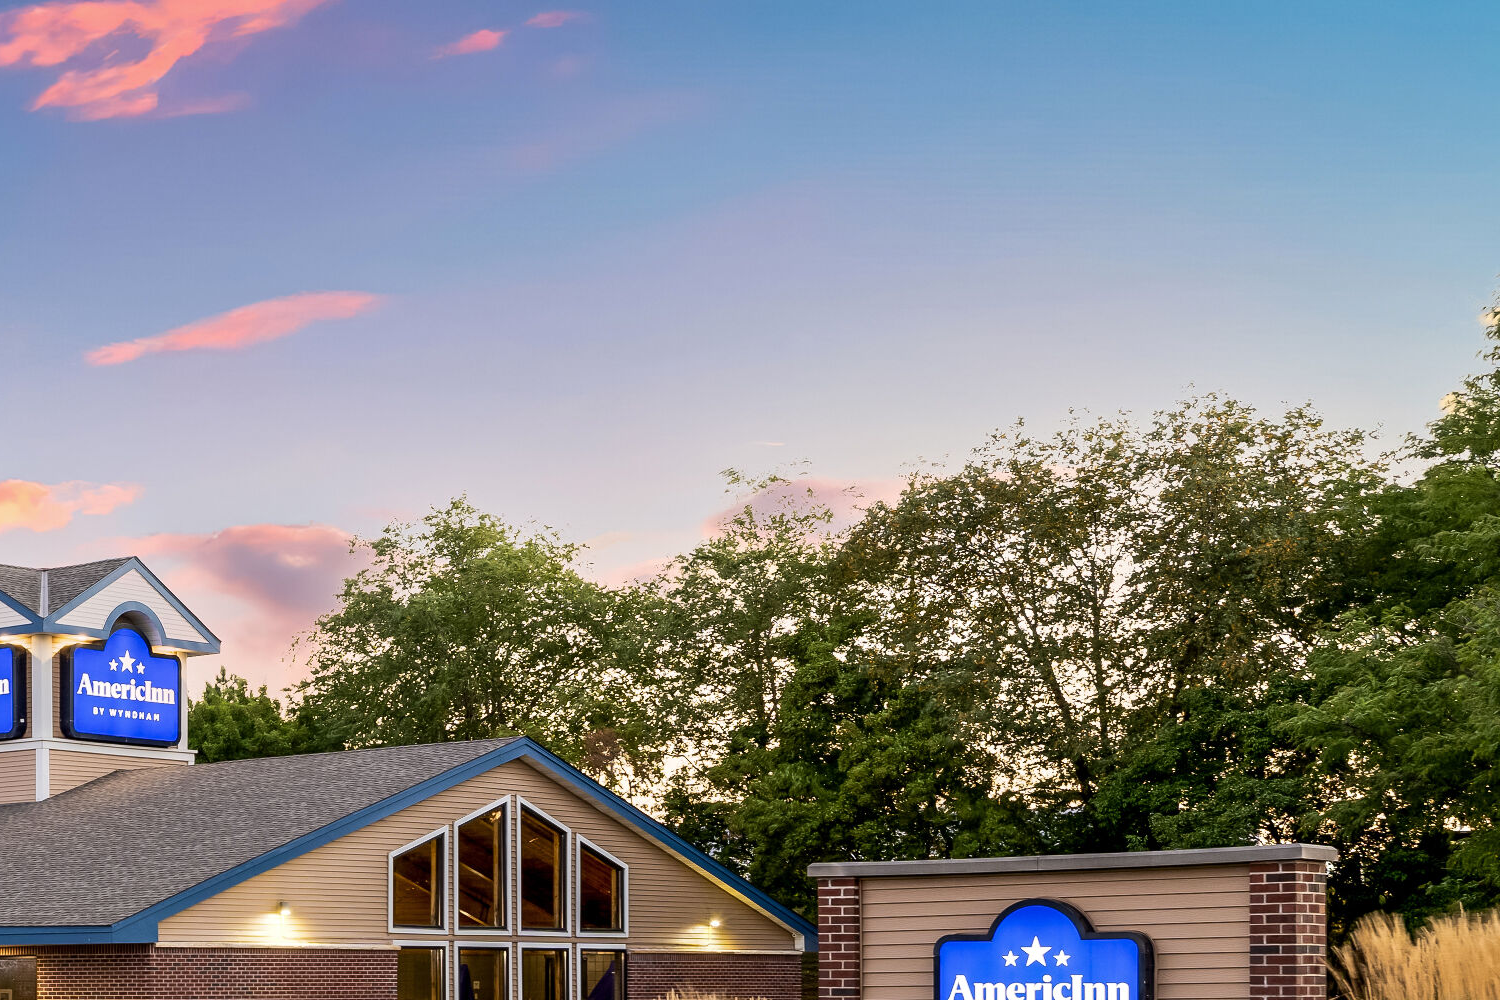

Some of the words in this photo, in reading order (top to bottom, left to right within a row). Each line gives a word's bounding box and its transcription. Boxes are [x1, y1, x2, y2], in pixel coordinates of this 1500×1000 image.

[77, 673, 176, 705] AmericInn
[93, 706, 105, 716] BY
[109, 708, 160, 722] WYNDHAM
